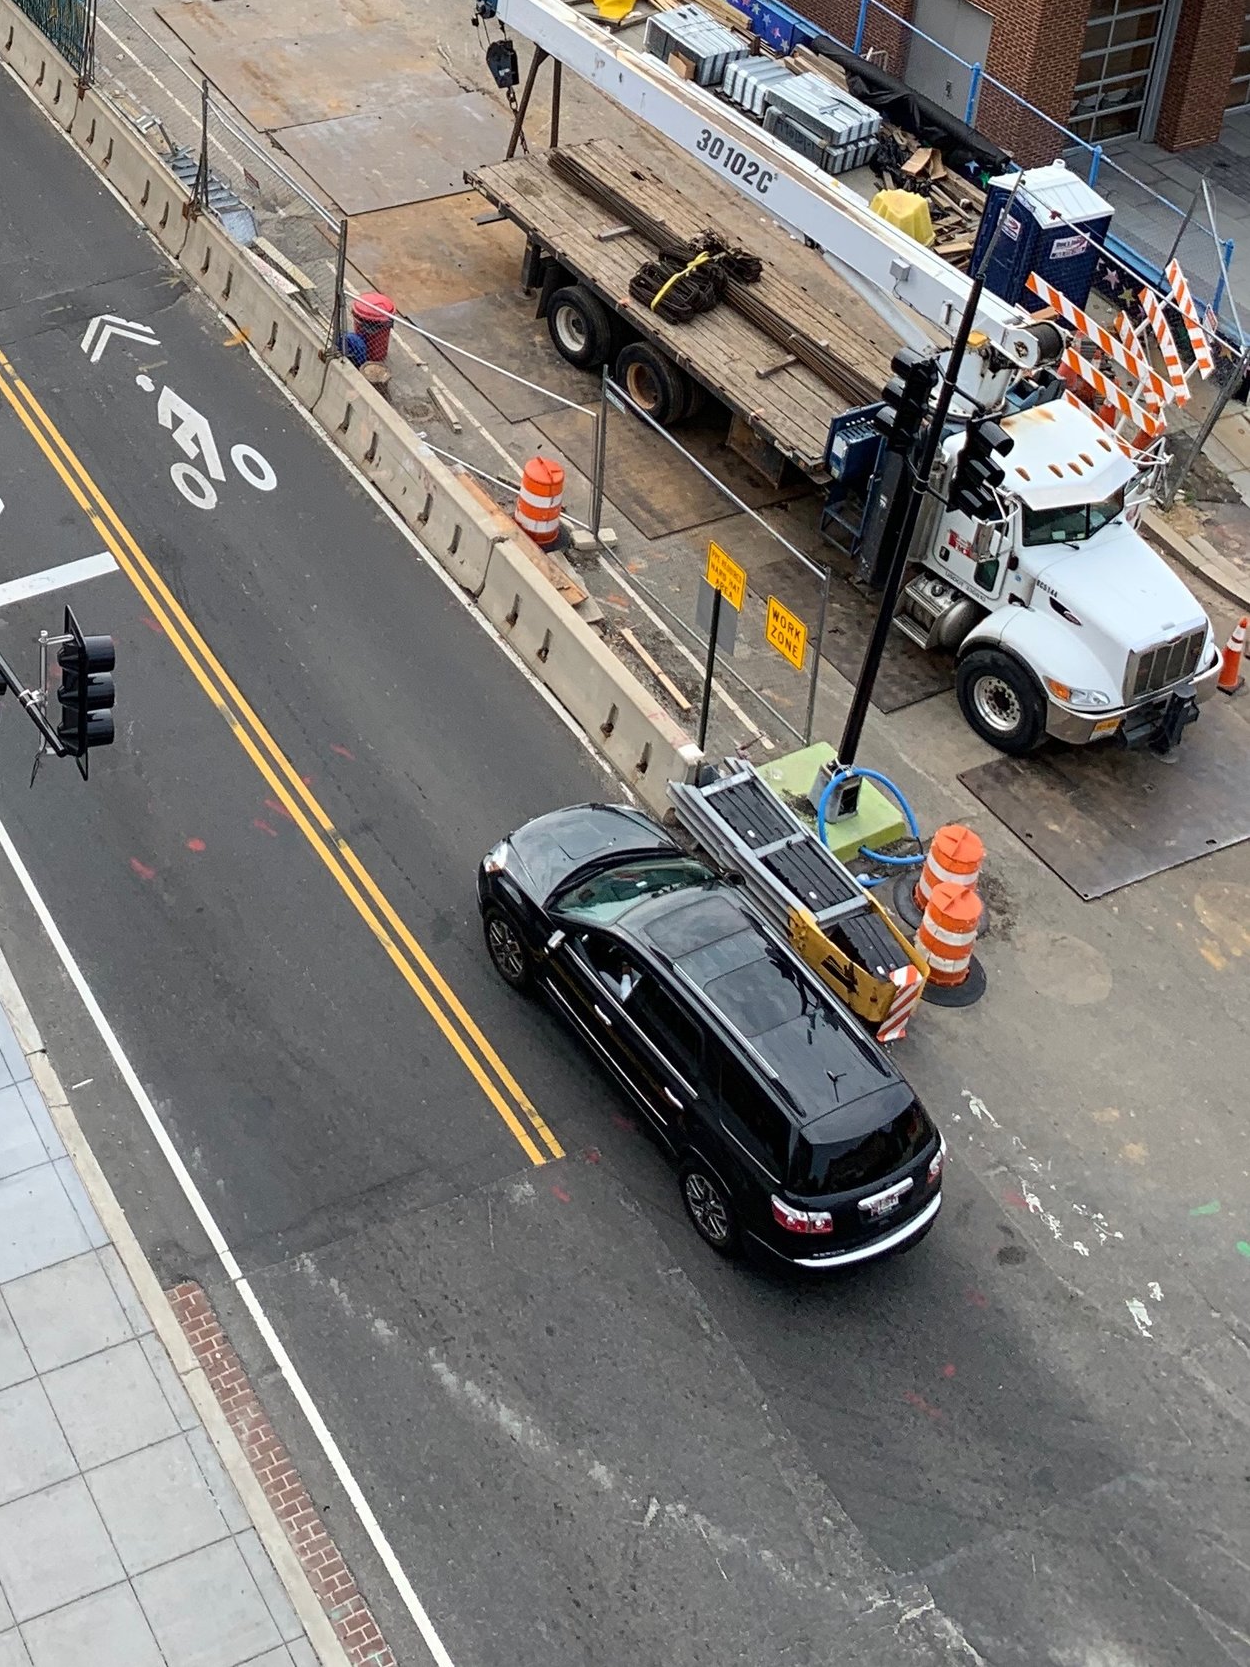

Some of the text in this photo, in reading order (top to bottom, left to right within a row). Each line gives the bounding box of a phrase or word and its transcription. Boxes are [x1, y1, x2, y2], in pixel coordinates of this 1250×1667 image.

[696, 128, 773, 194] 30102C
[710, 564, 727, 585] HARD
[770, 624, 798, 659] ZONE
[771, 606, 801, 642] WORK
